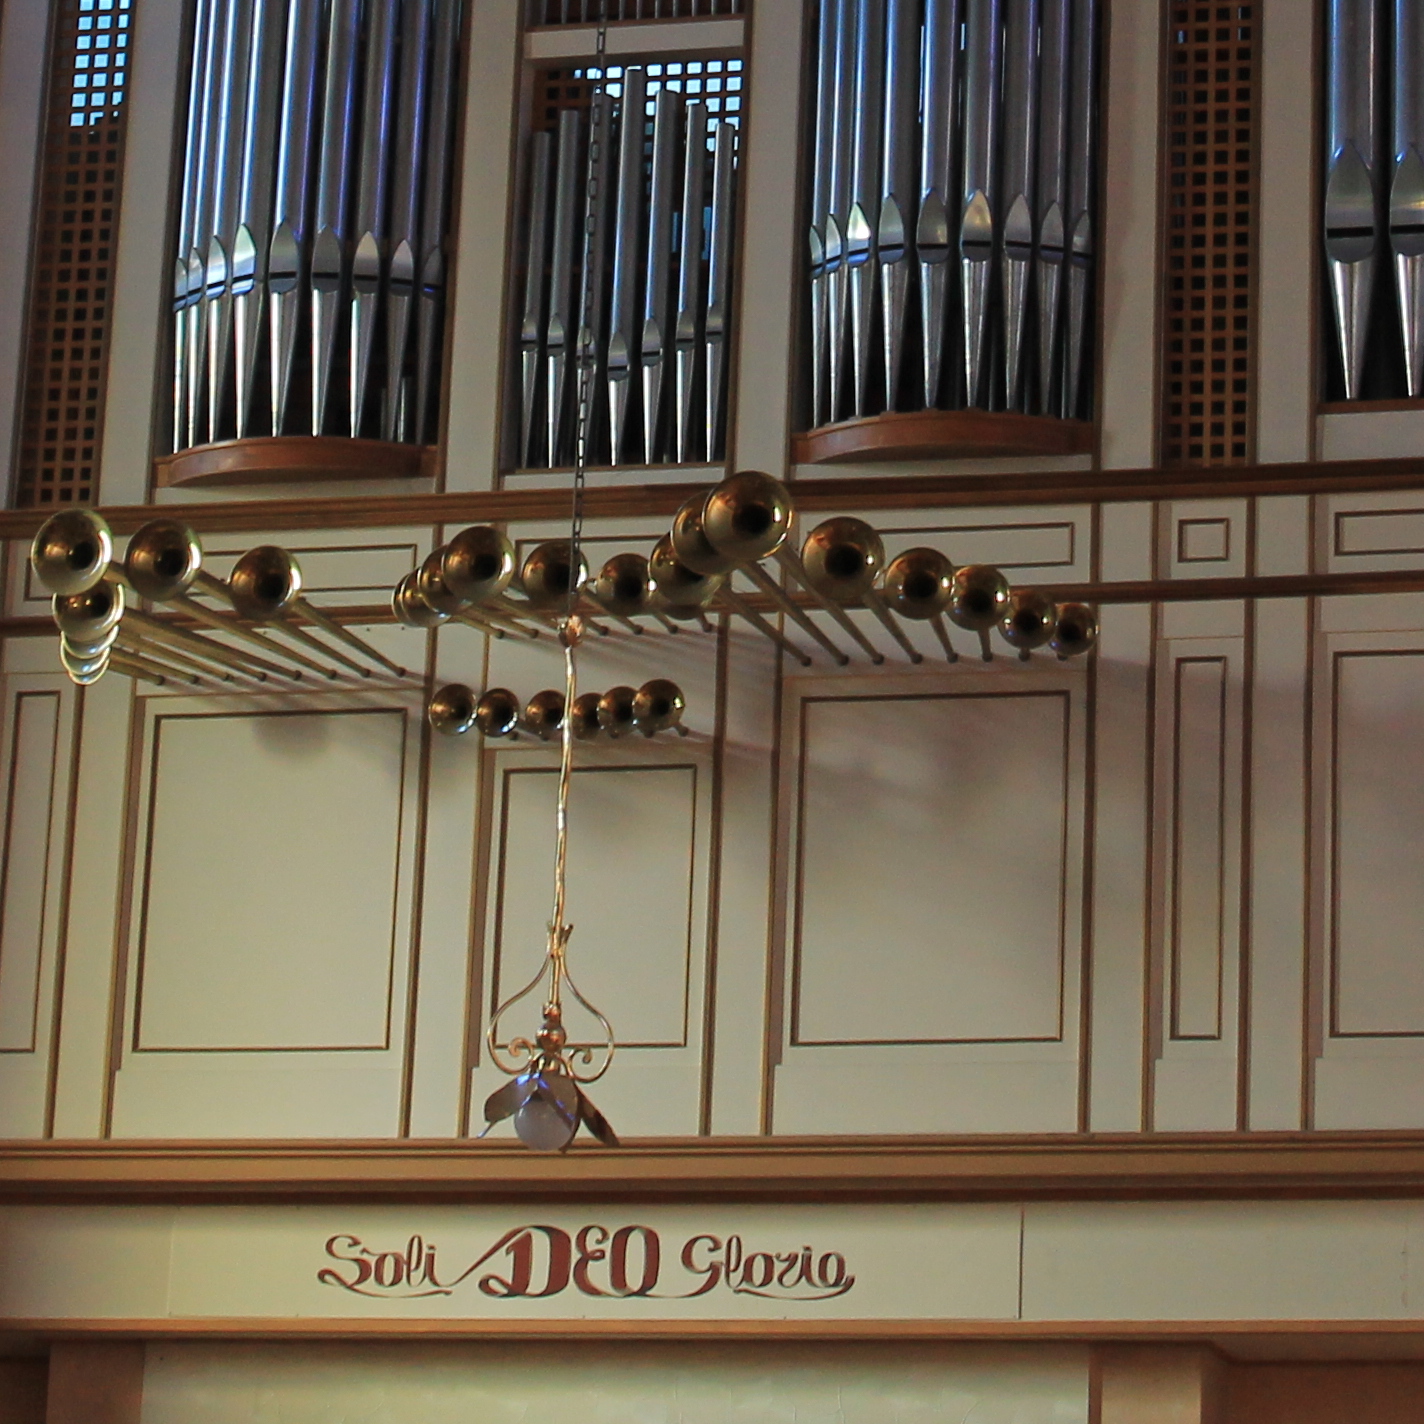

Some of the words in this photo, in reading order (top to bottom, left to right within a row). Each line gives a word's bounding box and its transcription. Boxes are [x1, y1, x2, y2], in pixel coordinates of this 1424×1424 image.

[317, 1234, 453, 1299] Soli
[468, 1224, 661, 1299] DEO
[681, 1234, 856, 1300] Gloria
